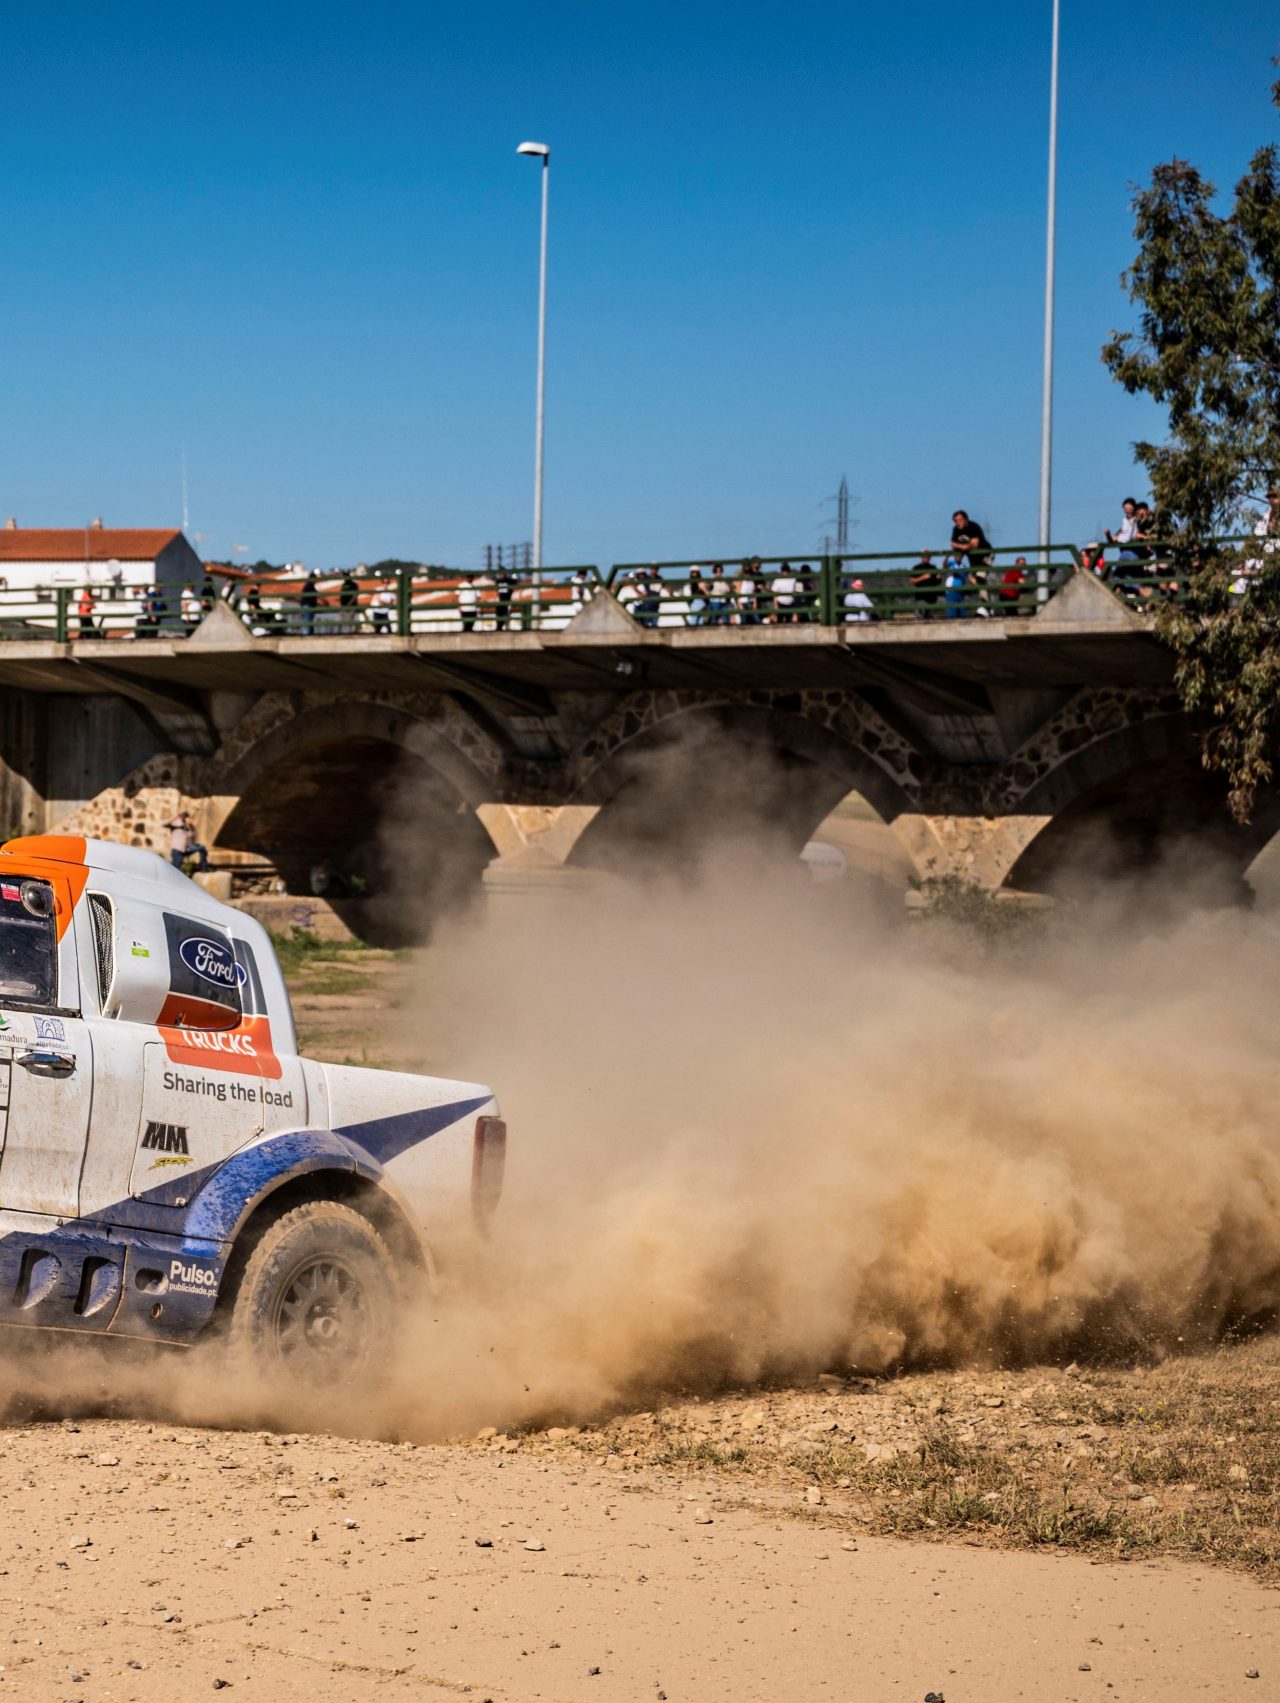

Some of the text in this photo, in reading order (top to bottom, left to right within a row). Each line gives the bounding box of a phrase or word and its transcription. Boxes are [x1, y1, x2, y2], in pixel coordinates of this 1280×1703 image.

[195, 942, 234, 982] Ford
[180, 1029, 257, 1057] TRUCKS
[163, 1071, 293, 1109] Sharing the load
[140, 1120, 190, 1156] MM
